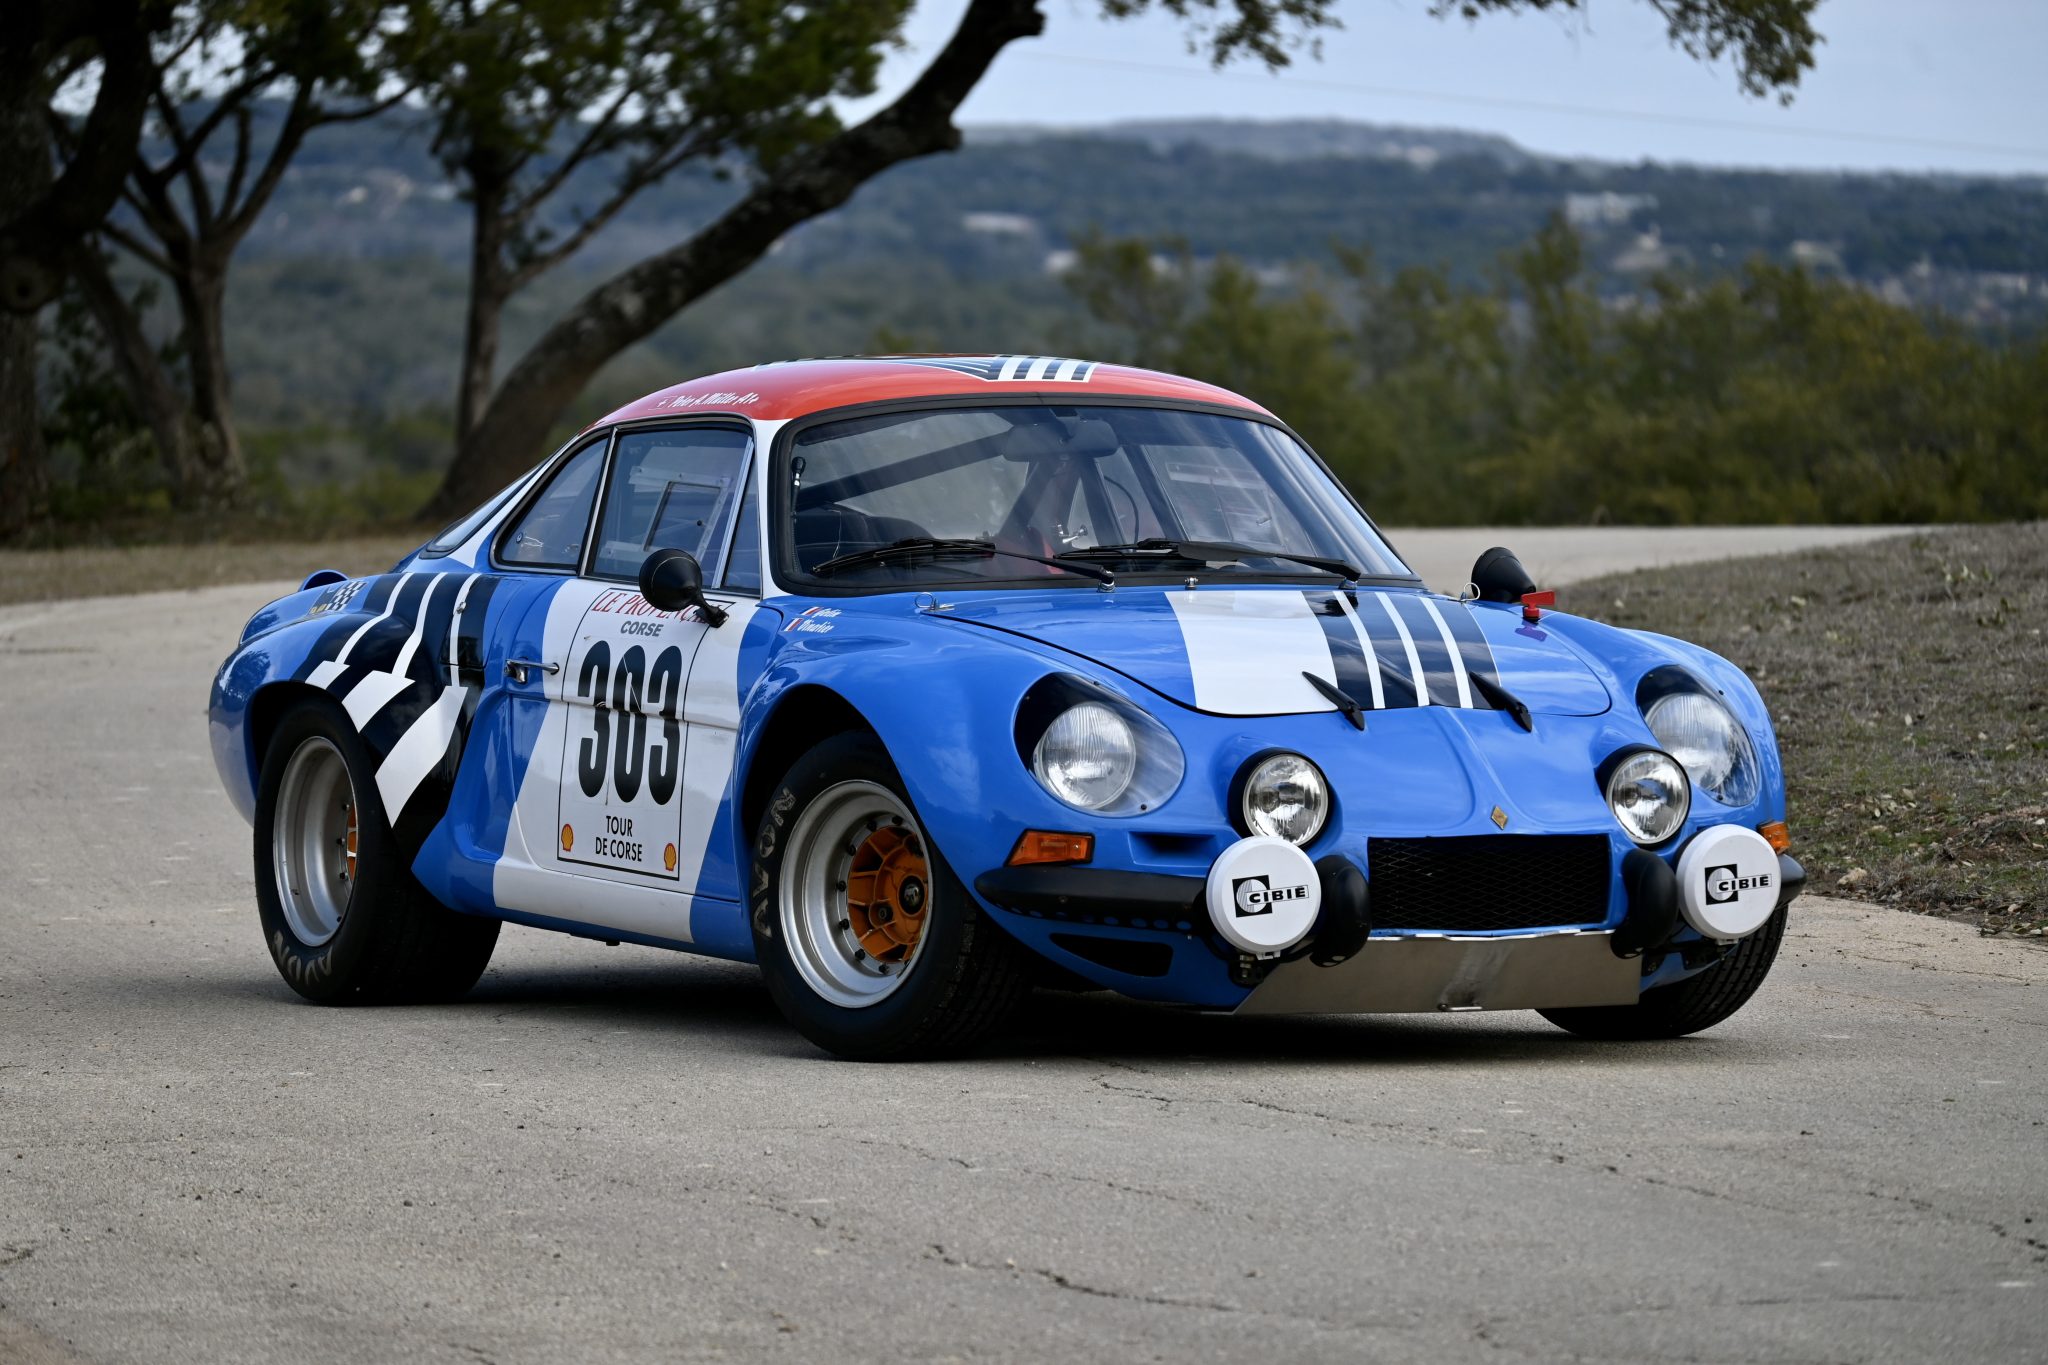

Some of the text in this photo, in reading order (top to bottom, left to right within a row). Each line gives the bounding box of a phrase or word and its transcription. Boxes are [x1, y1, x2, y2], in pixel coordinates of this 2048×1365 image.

[592, 591, 627, 612] LE
[620, 620, 664, 637] CORSE
[577, 640, 683, 805] 303
[606, 815, 633, 837] TOUR
[595, 836, 643, 862] DE CORSE
[752, 787, 797, 938] AVON
